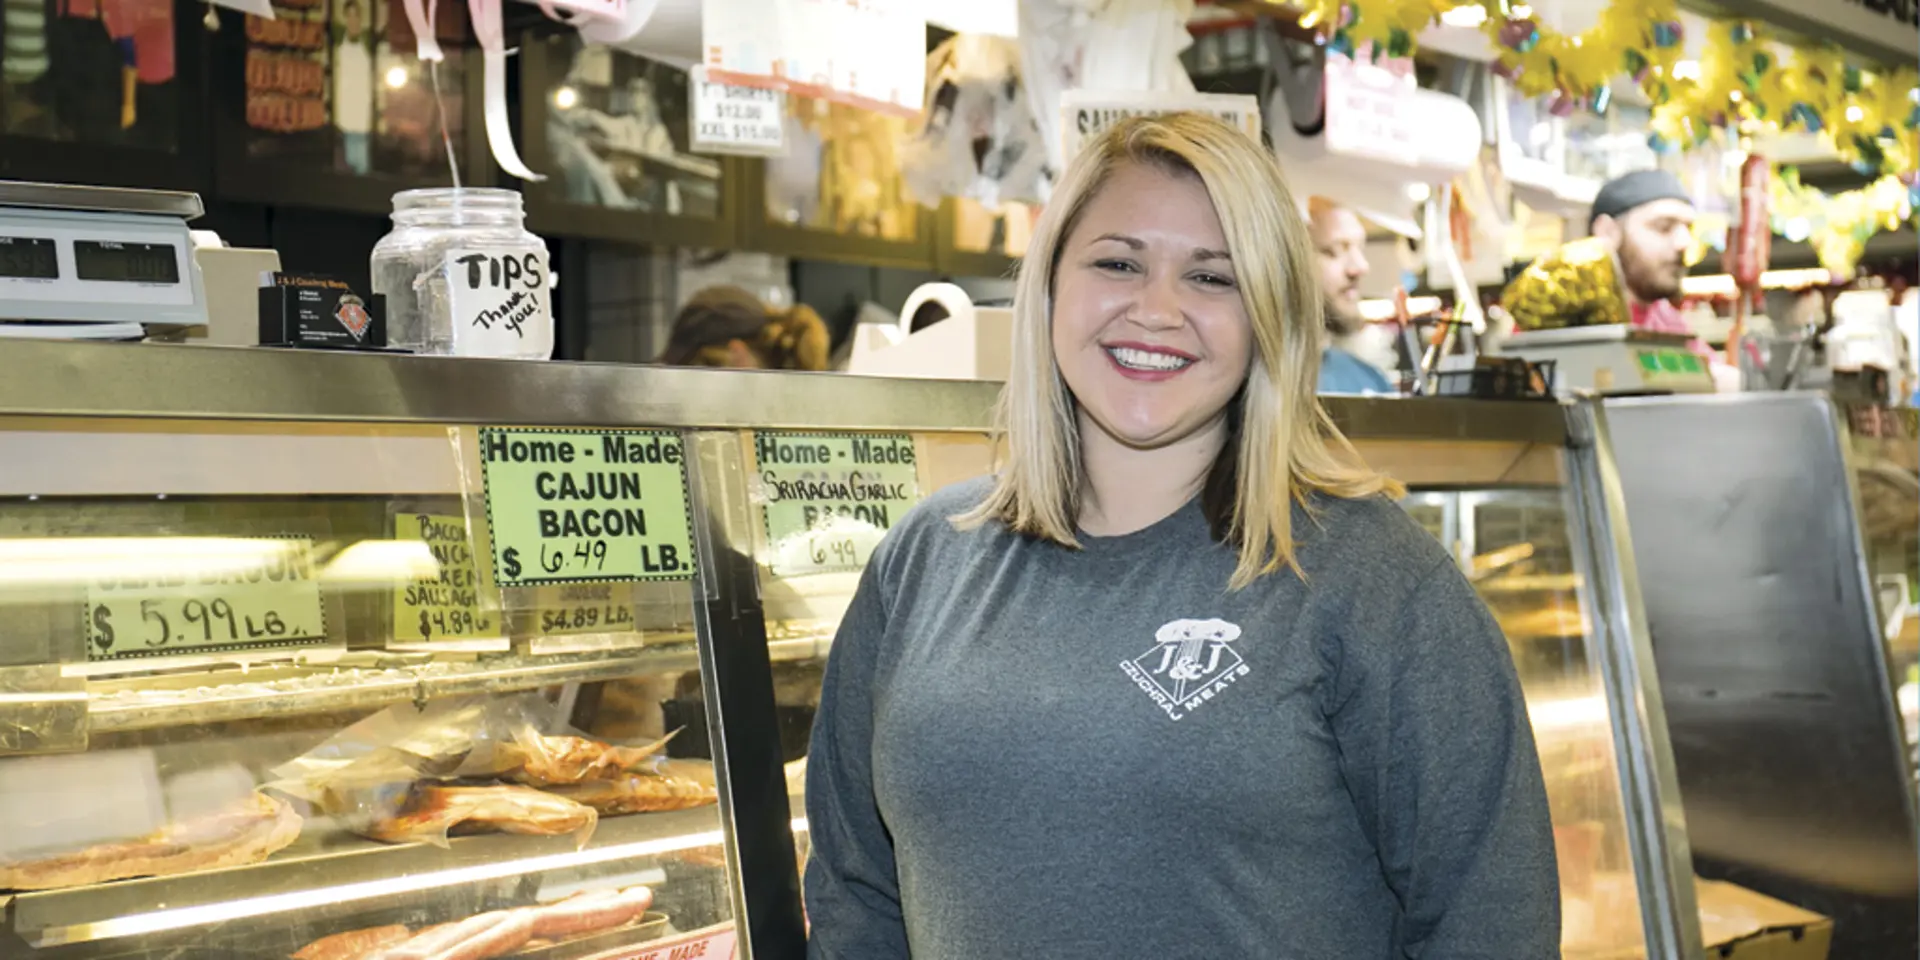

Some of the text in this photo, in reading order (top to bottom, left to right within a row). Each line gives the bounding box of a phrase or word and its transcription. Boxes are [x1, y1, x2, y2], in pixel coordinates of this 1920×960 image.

[455, 253, 542, 290] TIPS
[472, 291, 528, 330] Thank
[486, 433, 575, 463] Home
[602, 435, 680, 464] Made
[760, 437, 831, 464] Home
[852, 438, 913, 464] Made
[535, 471, 642, 500] CAJUN
[538, 508, 647, 538] BACON
[502, 546, 522, 581] $
[540, 539, 607, 573] 6.49
[640, 543, 689, 572] LB.
[93, 603, 115, 653] $
[140, 597, 239, 648] 5.99
[541, 605, 599, 636] $4.89
[1119, 659, 1251, 721] CZUCHRAJ MEATS
